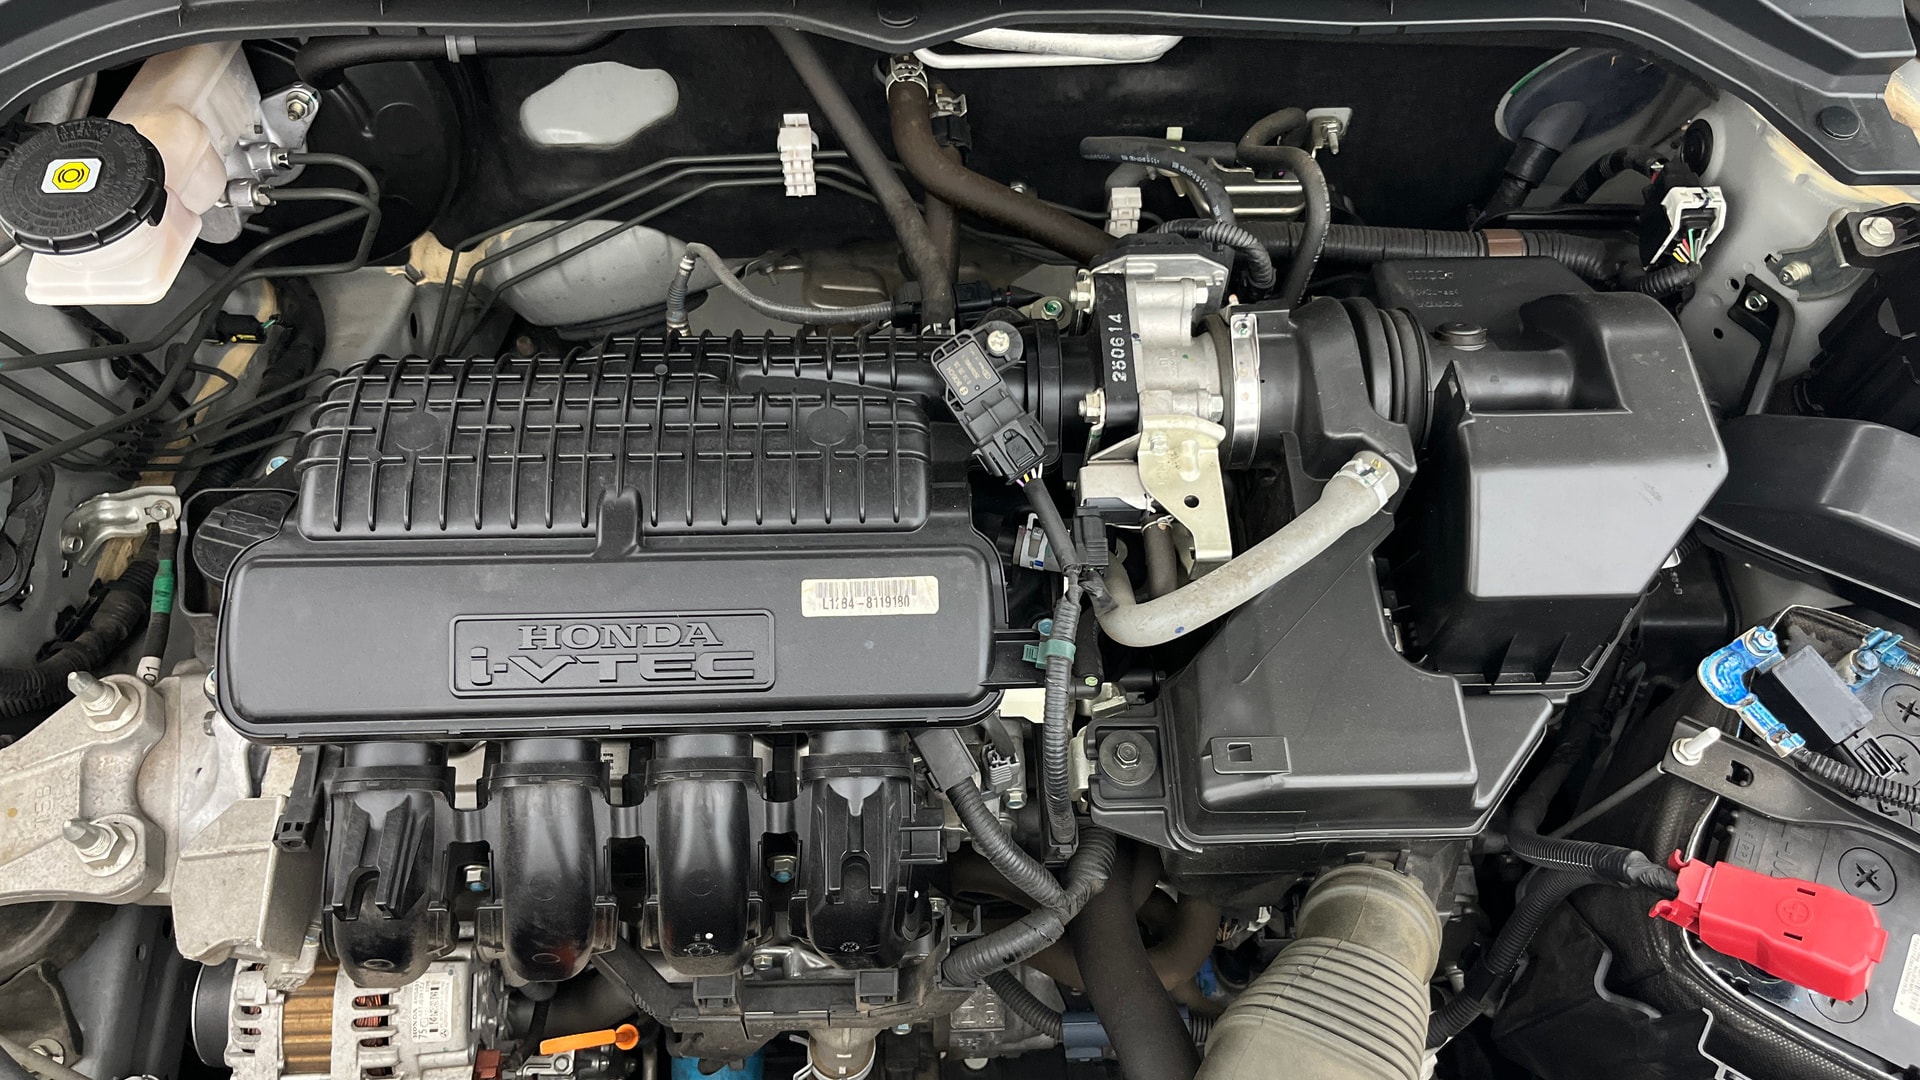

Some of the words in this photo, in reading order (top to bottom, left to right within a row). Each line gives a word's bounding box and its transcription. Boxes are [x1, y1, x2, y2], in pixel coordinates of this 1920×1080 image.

[1108, 313, 1127, 382] 250614
[518, 622, 723, 650] HONDA
[470, 647, 755, 685] i-VTEC
